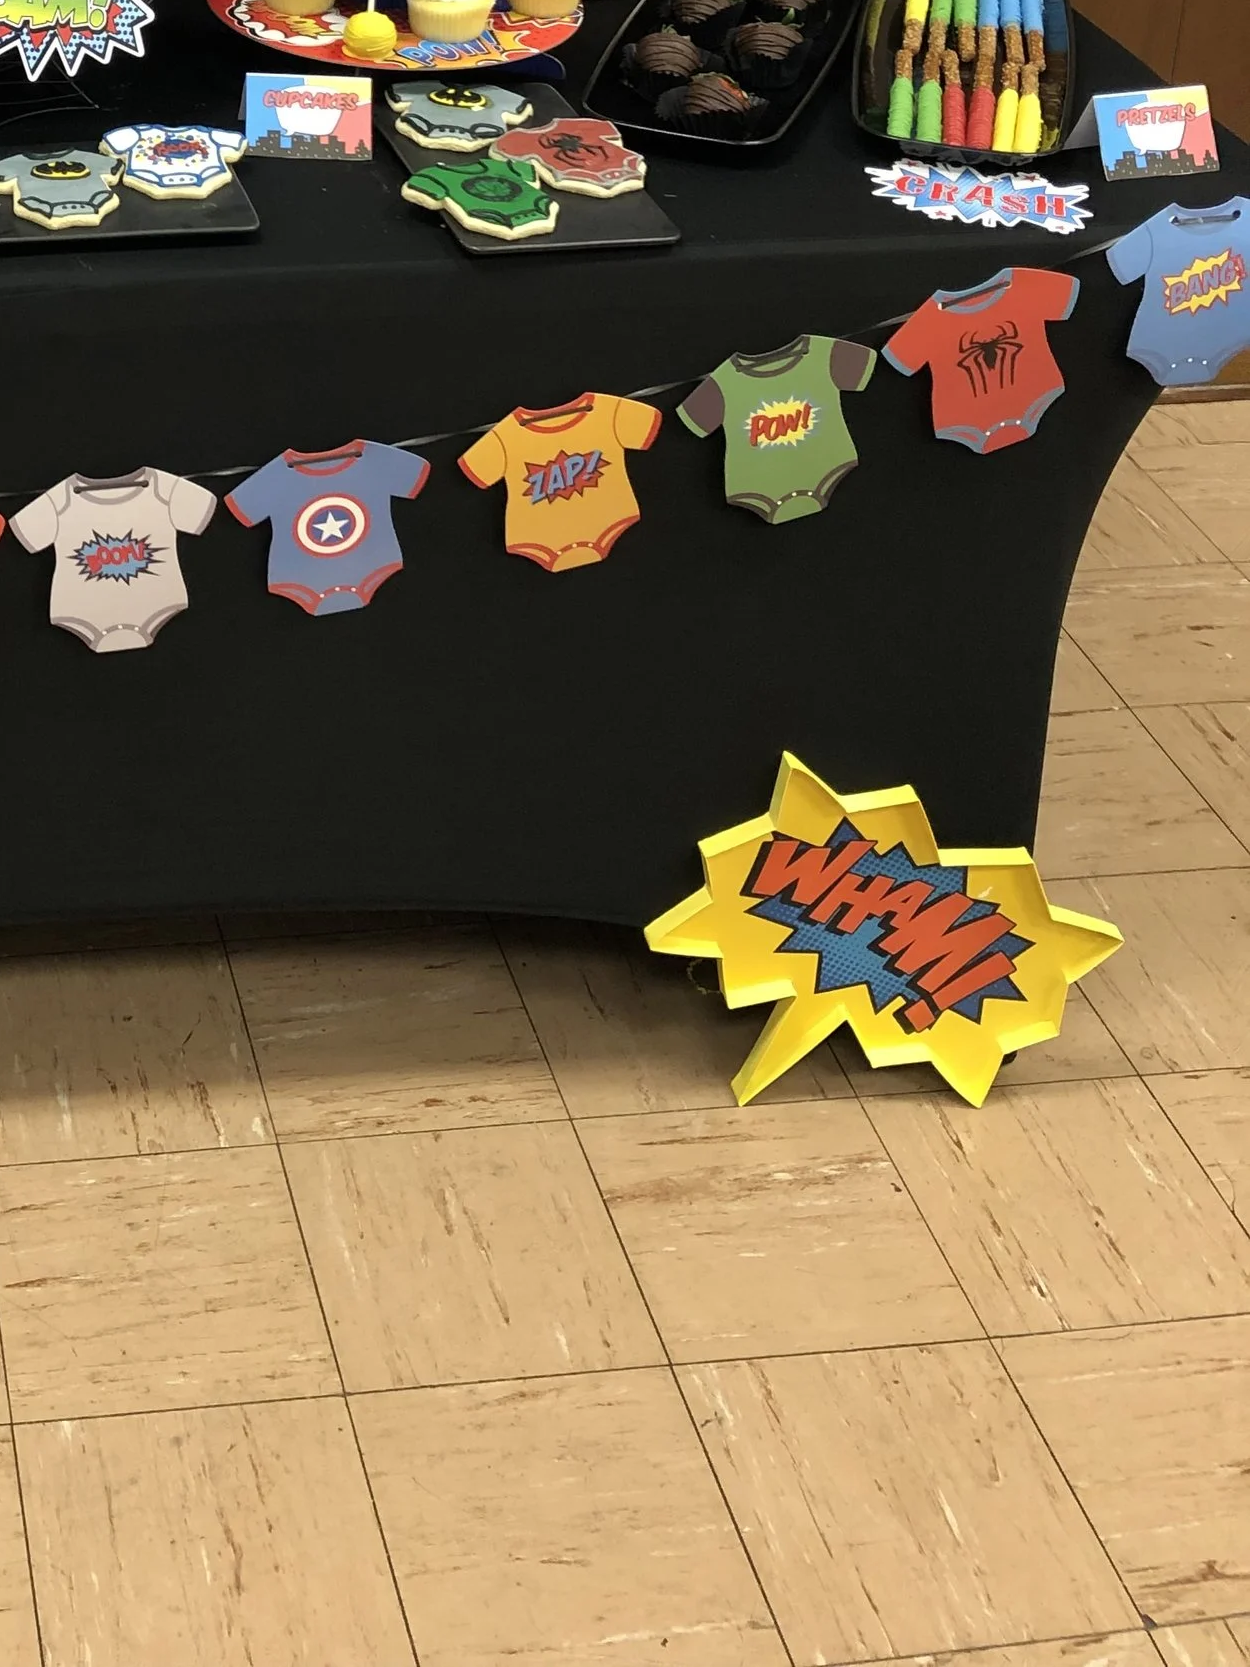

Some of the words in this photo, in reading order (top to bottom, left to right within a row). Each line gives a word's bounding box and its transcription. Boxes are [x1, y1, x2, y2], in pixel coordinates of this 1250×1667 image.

[263, 89, 359, 111] CUPCAKES
[1115, 101, 1196, 127] PRETZELS
[893, 174, 1068, 218] CRASH
[1169, 253, 1248, 310] BANG!
[750, 402, 813, 447] POW!
[528, 449, 603, 505] ZAP!
[743, 836, 1018, 1034] WHAM!
